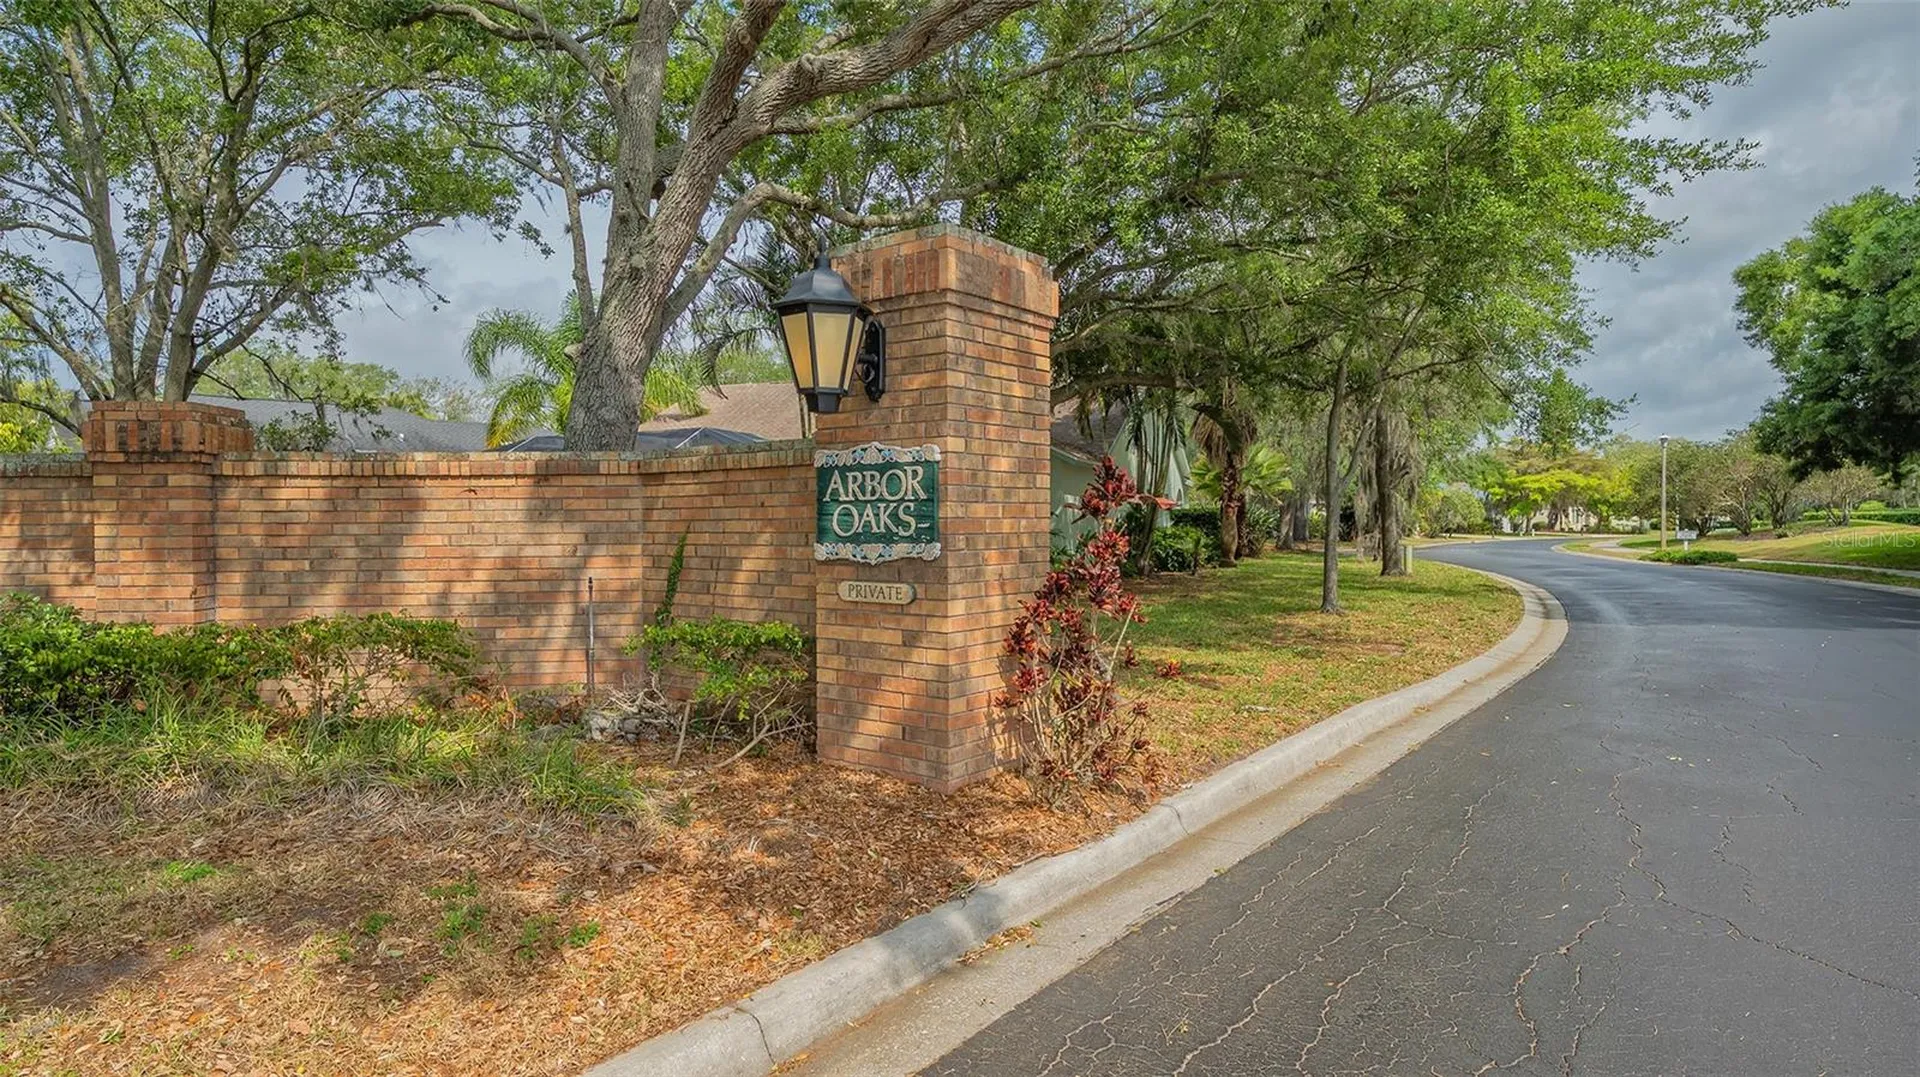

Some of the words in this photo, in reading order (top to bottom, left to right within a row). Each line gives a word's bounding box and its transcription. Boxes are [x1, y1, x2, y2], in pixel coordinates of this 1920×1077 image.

[823, 466, 927, 501] ARBOR
[832, 502, 916, 537] OAKS
[847, 583, 904, 600] PRIVATE
